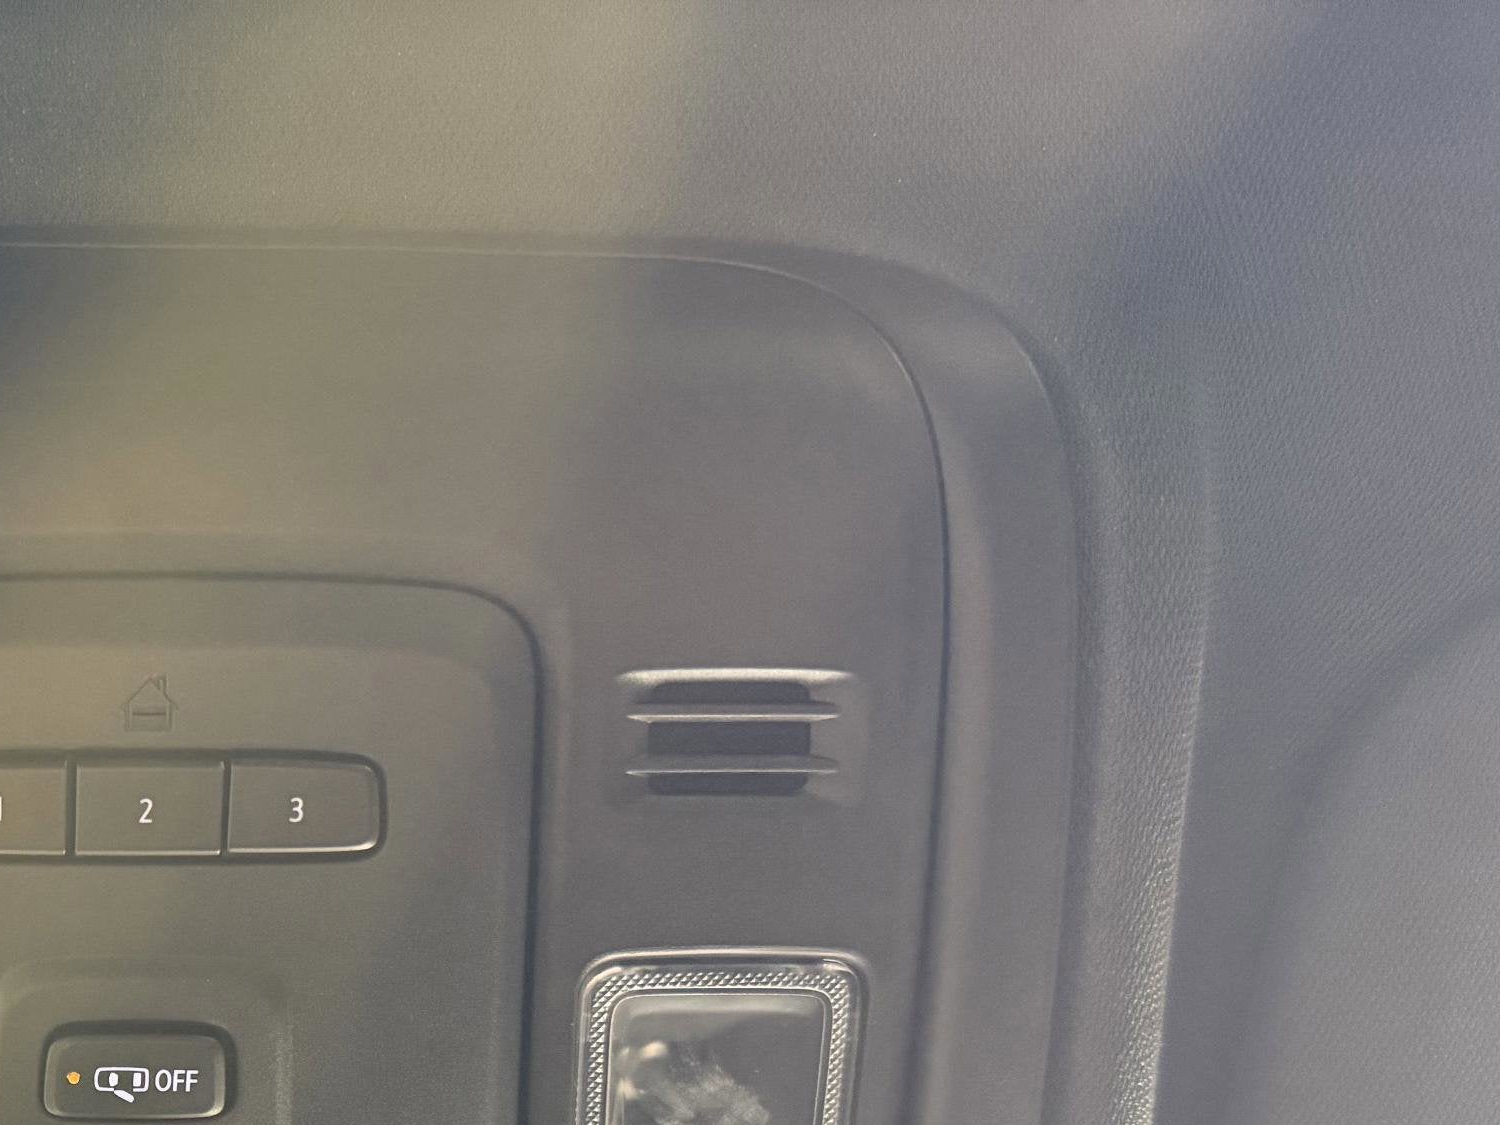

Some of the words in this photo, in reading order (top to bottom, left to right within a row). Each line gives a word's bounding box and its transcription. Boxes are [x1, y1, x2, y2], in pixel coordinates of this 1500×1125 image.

[138, 798, 154, 824] 2
[288, 797, 304, 823] 3
[154, 1070, 199, 1092] OFF
